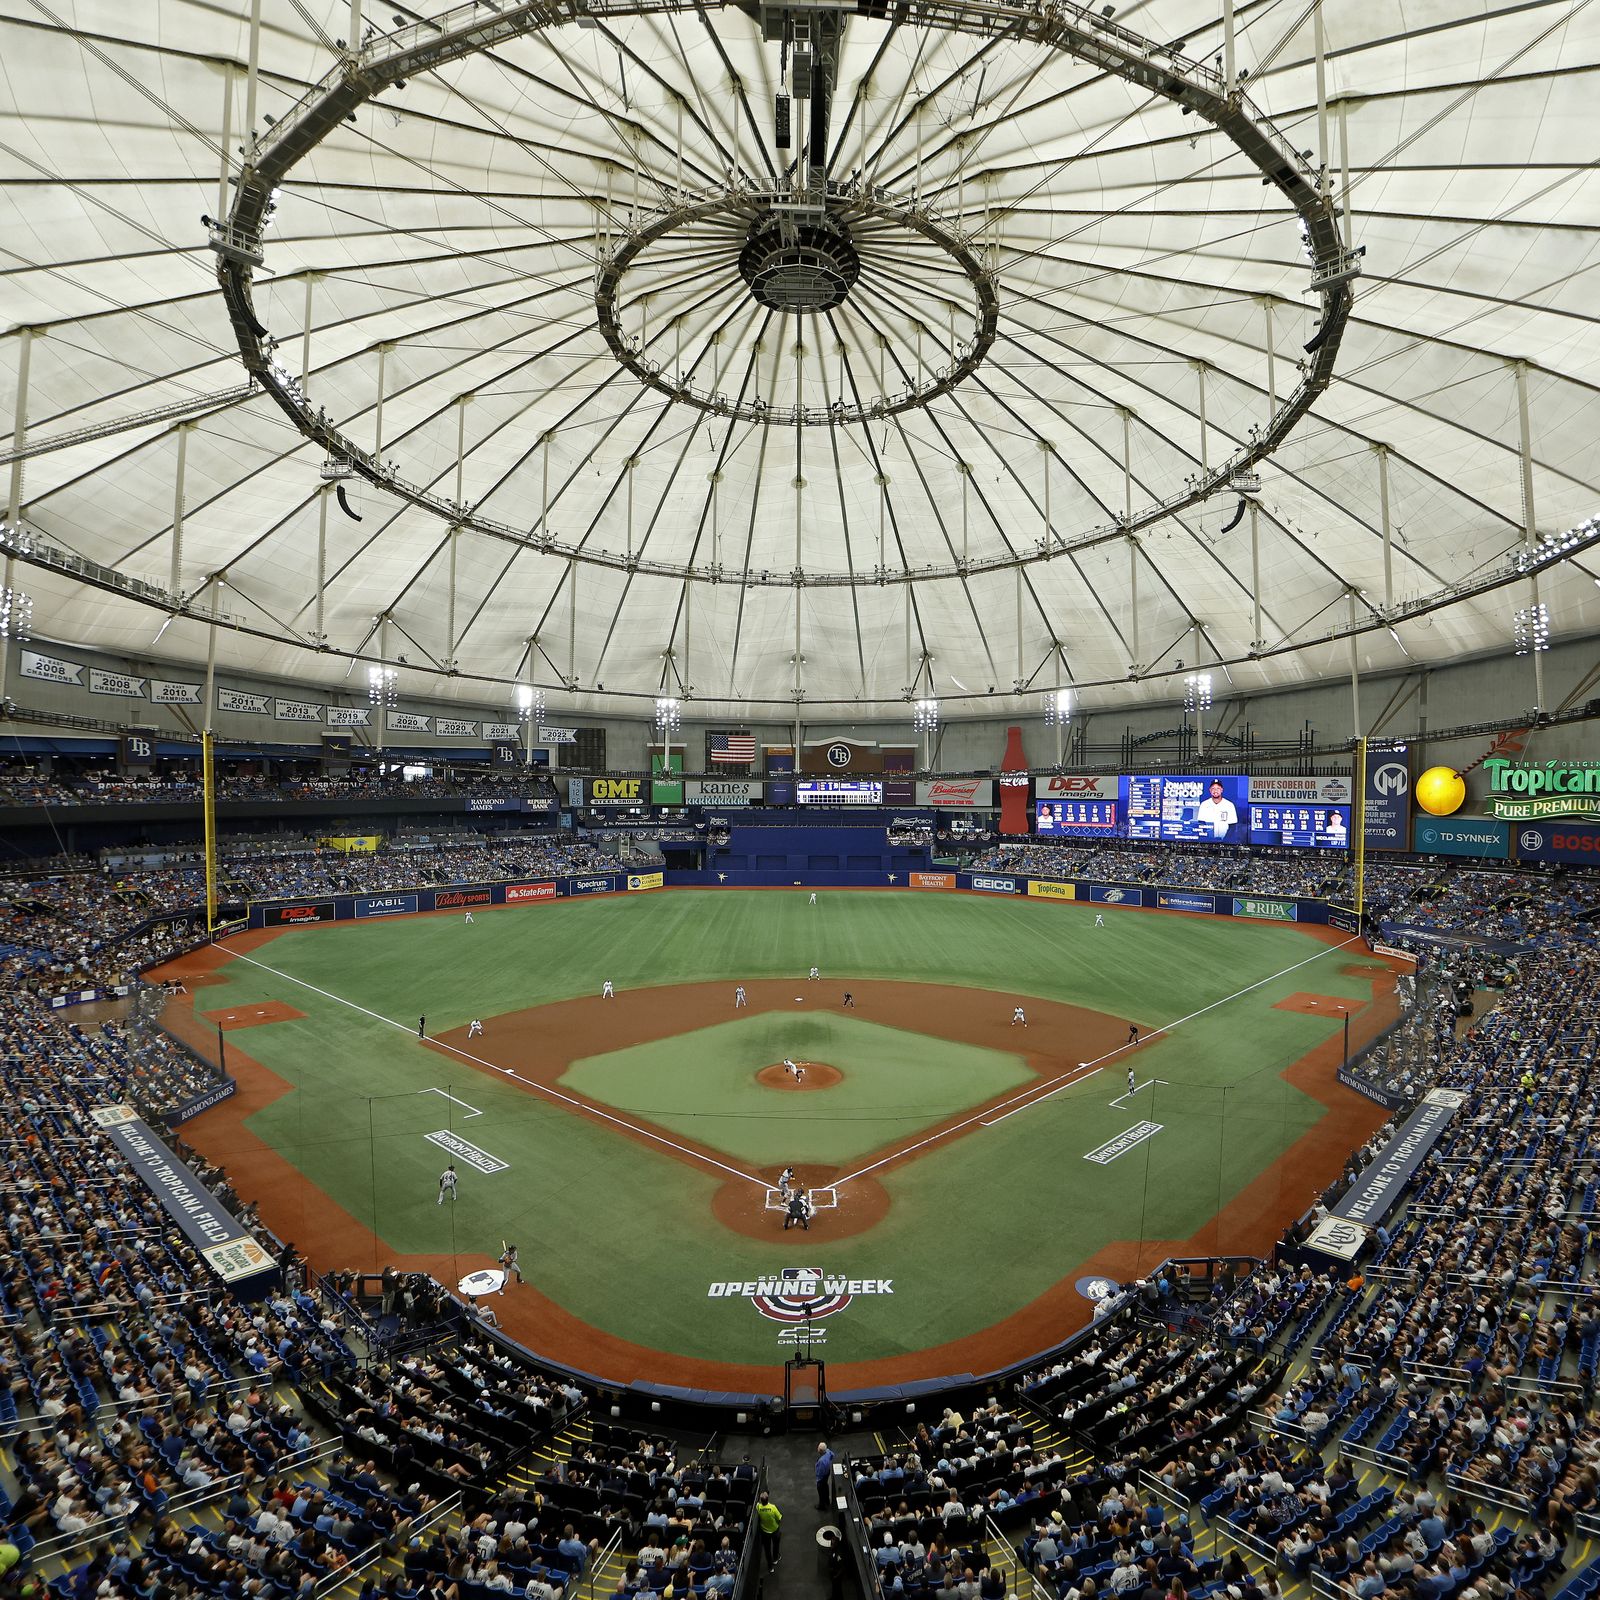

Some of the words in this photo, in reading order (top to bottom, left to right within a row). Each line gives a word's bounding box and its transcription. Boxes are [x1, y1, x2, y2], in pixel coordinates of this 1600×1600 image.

[36, 662, 65, 675] 2008
[26, 668, 73, 683] CHAMPIONS
[91, 672, 120, 680] AMERICAN
[94, 684, 138, 696] CHAMPIONS
[102, 678, 130, 689] 2008
[162, 688, 187, 697] 2010
[222, 702, 240, 710] WILD
[242, 704, 262, 712] CARD
[231, 696, 254, 706] 2011
[286, 706, 308, 714] 2013
[336, 712, 358, 720] 2019
[396, 718, 418, 726] 2020
[128, 737, 150, 756] TB
[497, 746, 513, 762] TB
[832, 748, 847, 763] TB
[592, 779, 641, 798] GMF
[934, 785, 976, 794] Budweiser
[1048, 777, 1100, 791] DEX
[1165, 782, 1204, 790] JONATHAN
[1253, 781, 1277, 789] DRIVE
[1277, 781, 1304, 789] SOBER
[1305, 781, 1316, 789] OR
[1164, 789, 1204, 798] SCHOOP
[1251, 790, 1266, 798] GET
[1266, 790, 1296, 799] PULLED
[1297, 790, 1318, 799] OVER
[1494, 802, 1530, 816] PURE
[1532, 798, 1600, 816] PREMIUM
[1440, 832, 1454, 841] TD
[1456, 834, 1500, 844] SYNNEX
[577, 880, 608, 889] Spectrum
[974, 878, 1014, 891] GEICO
[1037, 884, 1066, 895] Tropicana
[369, 899, 405, 908] JABIL
[436, 892, 467, 906] Bally
[467, 894, 490, 902] SPORTS
[1170, 898, 1212, 906] MicroLumen
[281, 906, 317, 919] DEX
[1256, 902, 1286, 916] RIPA
[1340, 1072, 1368, 1094] RAYMOND
[1368, 1090, 1388, 1106] JAMES
[182, 1097, 214, 1120] RAYMOND
[214, 1085, 234, 1102] JAMES
[1420, 1106, 1444, 1124] FIELD
[117, 1123, 156, 1156] WELCOME
[1091, 1138, 1132, 1161] BAYFRONT
[1126, 1123, 1157, 1142] HEALTH
[1390, 1124, 1431, 1162] TROPICANA
[432, 1130, 472, 1157] BAYFRONT
[468, 1150, 500, 1170] HEALTH
[144, 1154, 164, 1166] TO
[1381, 1163, 1401, 1174] TO
[153, 1164, 204, 1214] TROPICANA
[1346, 1174, 1393, 1219] WELCOME
[192, 1212, 230, 1242] FIELD
[708, 1280, 816, 1297] OPENING
[824, 1279, 894, 1295] WEEK
